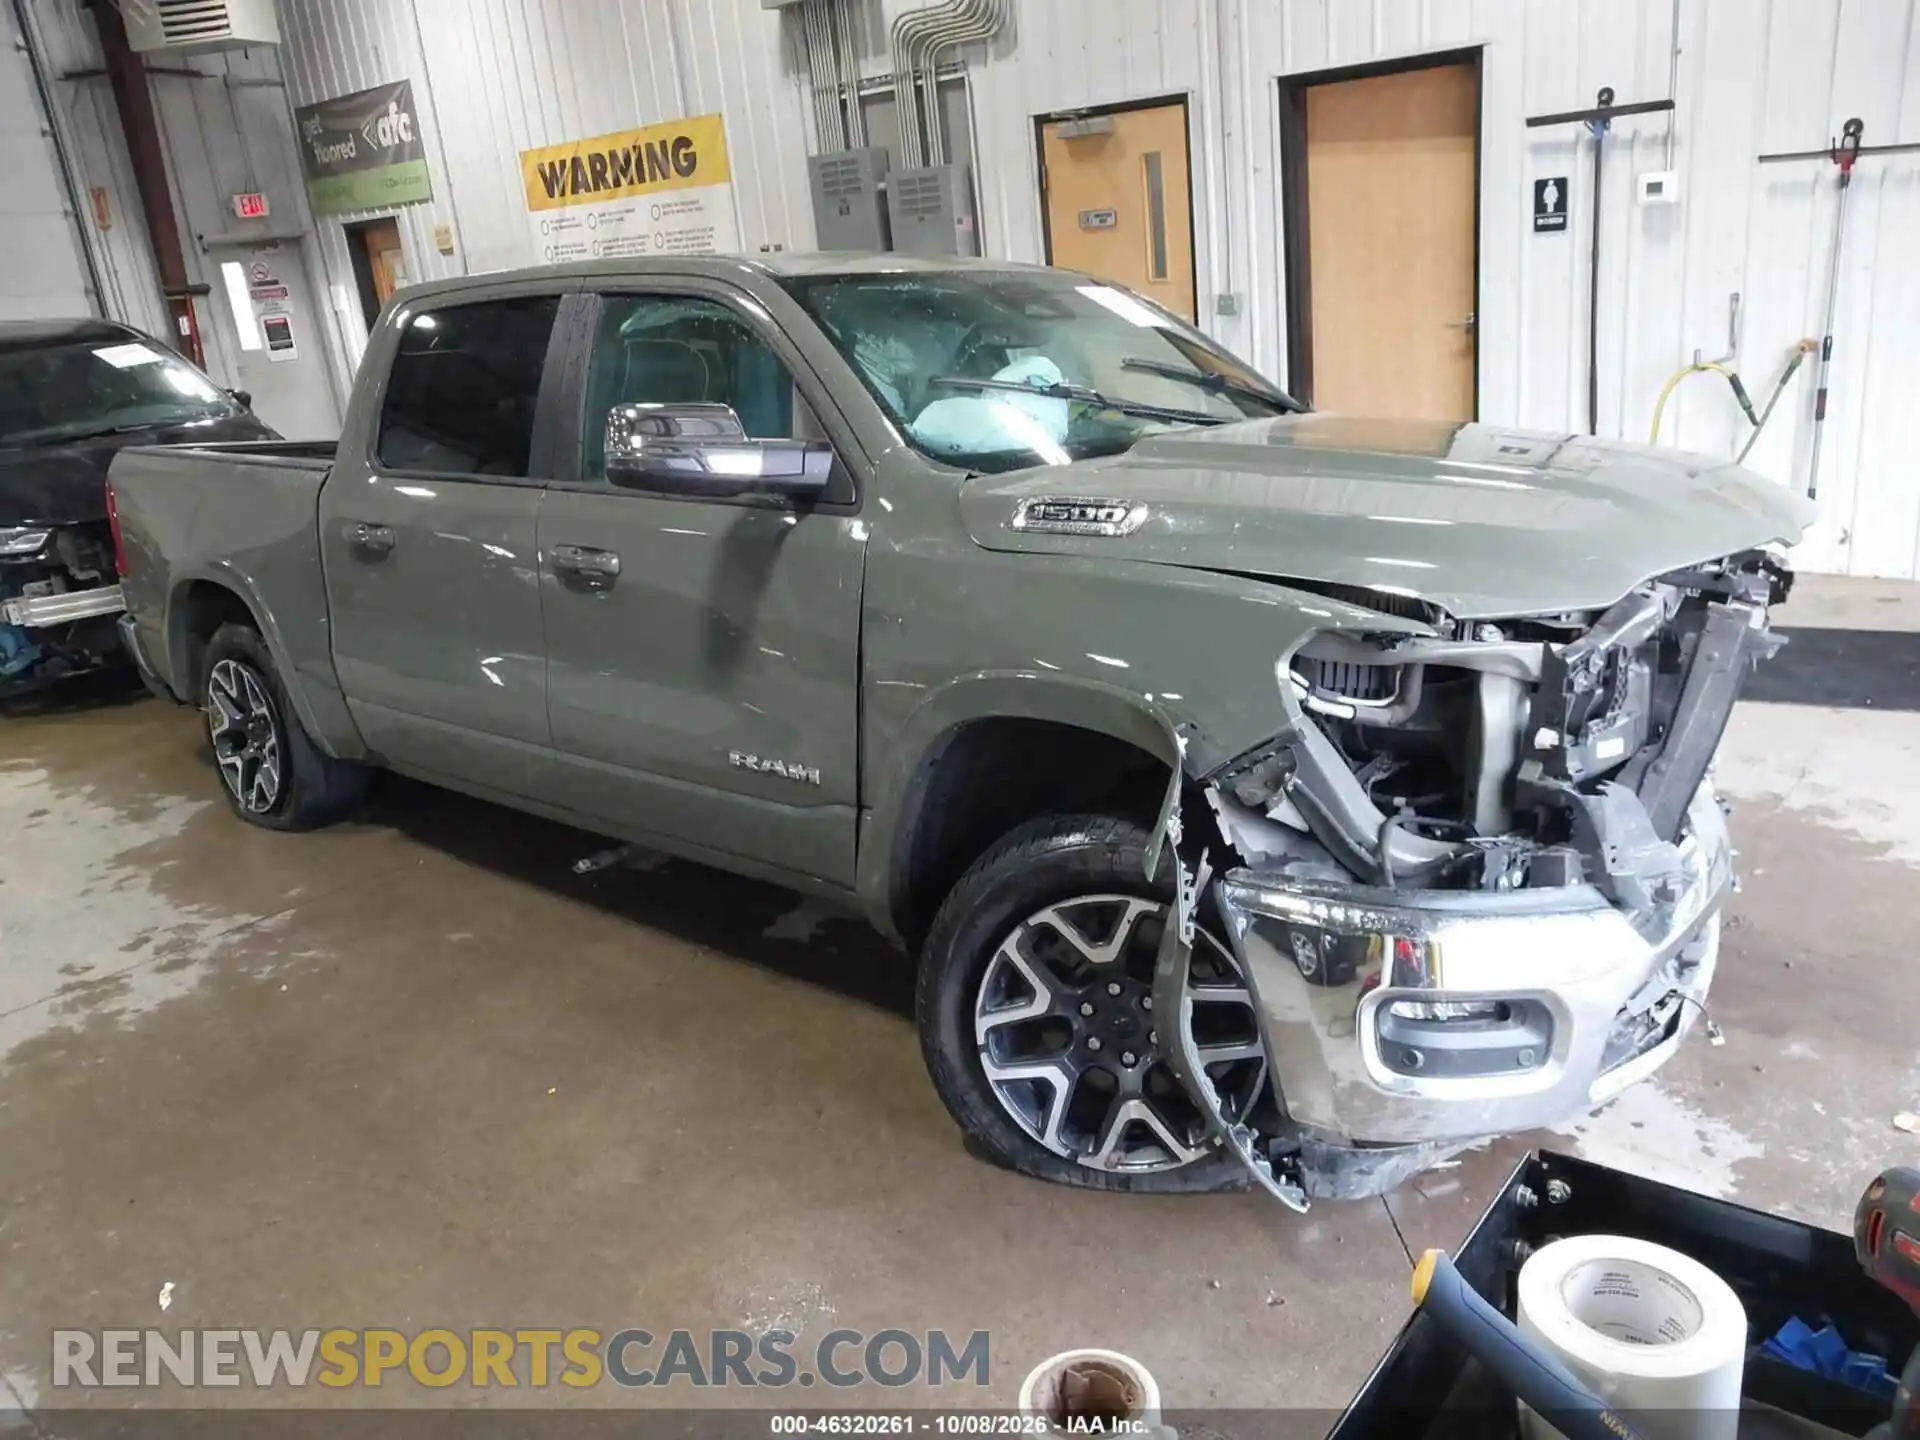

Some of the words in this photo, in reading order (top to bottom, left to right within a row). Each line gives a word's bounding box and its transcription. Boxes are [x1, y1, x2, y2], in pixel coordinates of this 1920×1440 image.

[377, 100, 412, 148] afc
[536, 135, 698, 199] WARNING
[241, 194, 264, 215] EXIT
[1031, 504, 1128, 522] 1500
[728, 751, 821, 785] RAM
